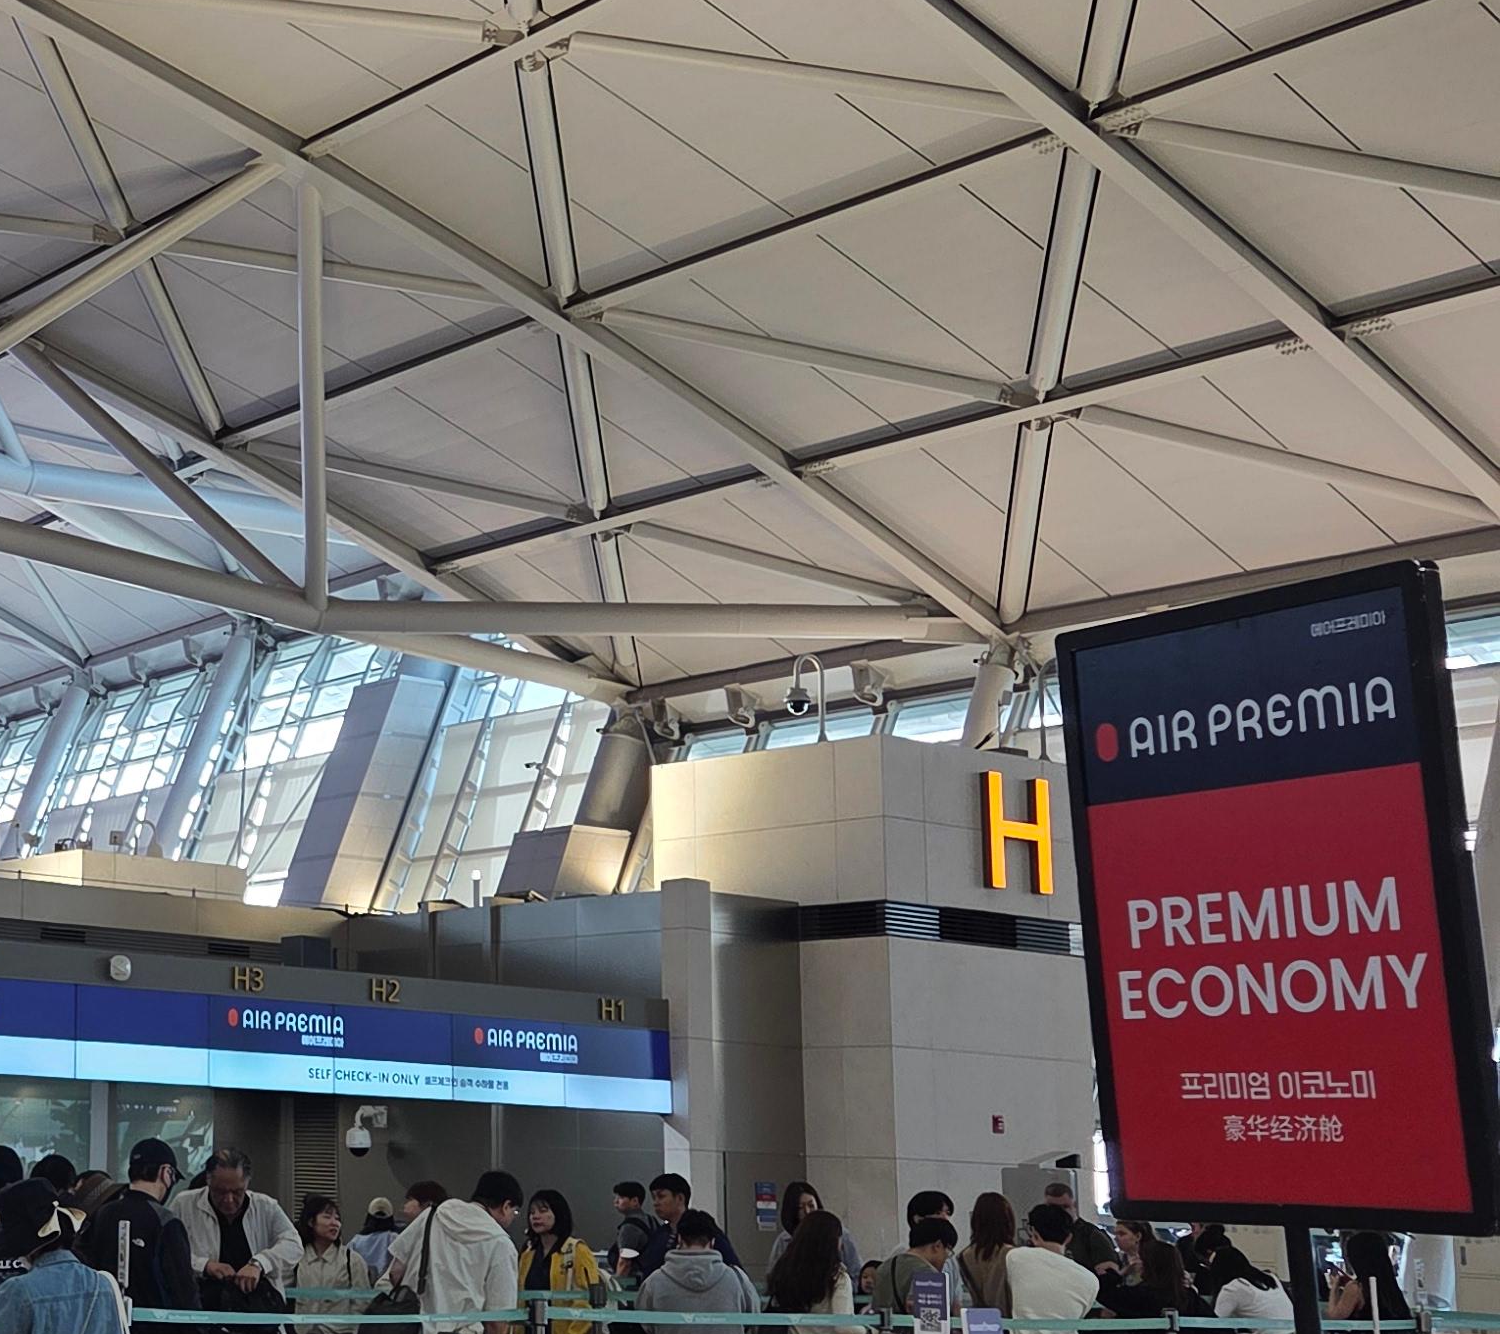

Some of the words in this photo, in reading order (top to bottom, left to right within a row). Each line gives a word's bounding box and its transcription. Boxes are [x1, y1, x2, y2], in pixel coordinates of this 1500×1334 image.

[1128, 707, 1199, 758] AIR
[1207, 675, 1397, 747] PREMIA
[981, 770, 1054, 895] H
[1126, 876, 1402, 949] PREMIUM
[232, 966, 265, 992] H3
[370, 978, 401, 1004] H2
[1117, 952, 1429, 1020] ECONOMY
[242, 1009, 272, 1030] AIR
[275, 1012, 344, 1036] PREMIA
[599, 998, 627, 1022] H1
[487, 1028, 513, 1048] AIR
[516, 1030, 578, 1053] PREMIA
[308, 1067, 332, 1080] SELF
[335, 1069, 390, 1083] CHECK-IN
[392, 1073, 420, 1086] ONLY
[1180, 1072, 1271, 1101] 프리미엄
[1278, 1070, 1377, 1100] 이코노미
[1223, 1113, 1345, 1144] 豪华经济舱
